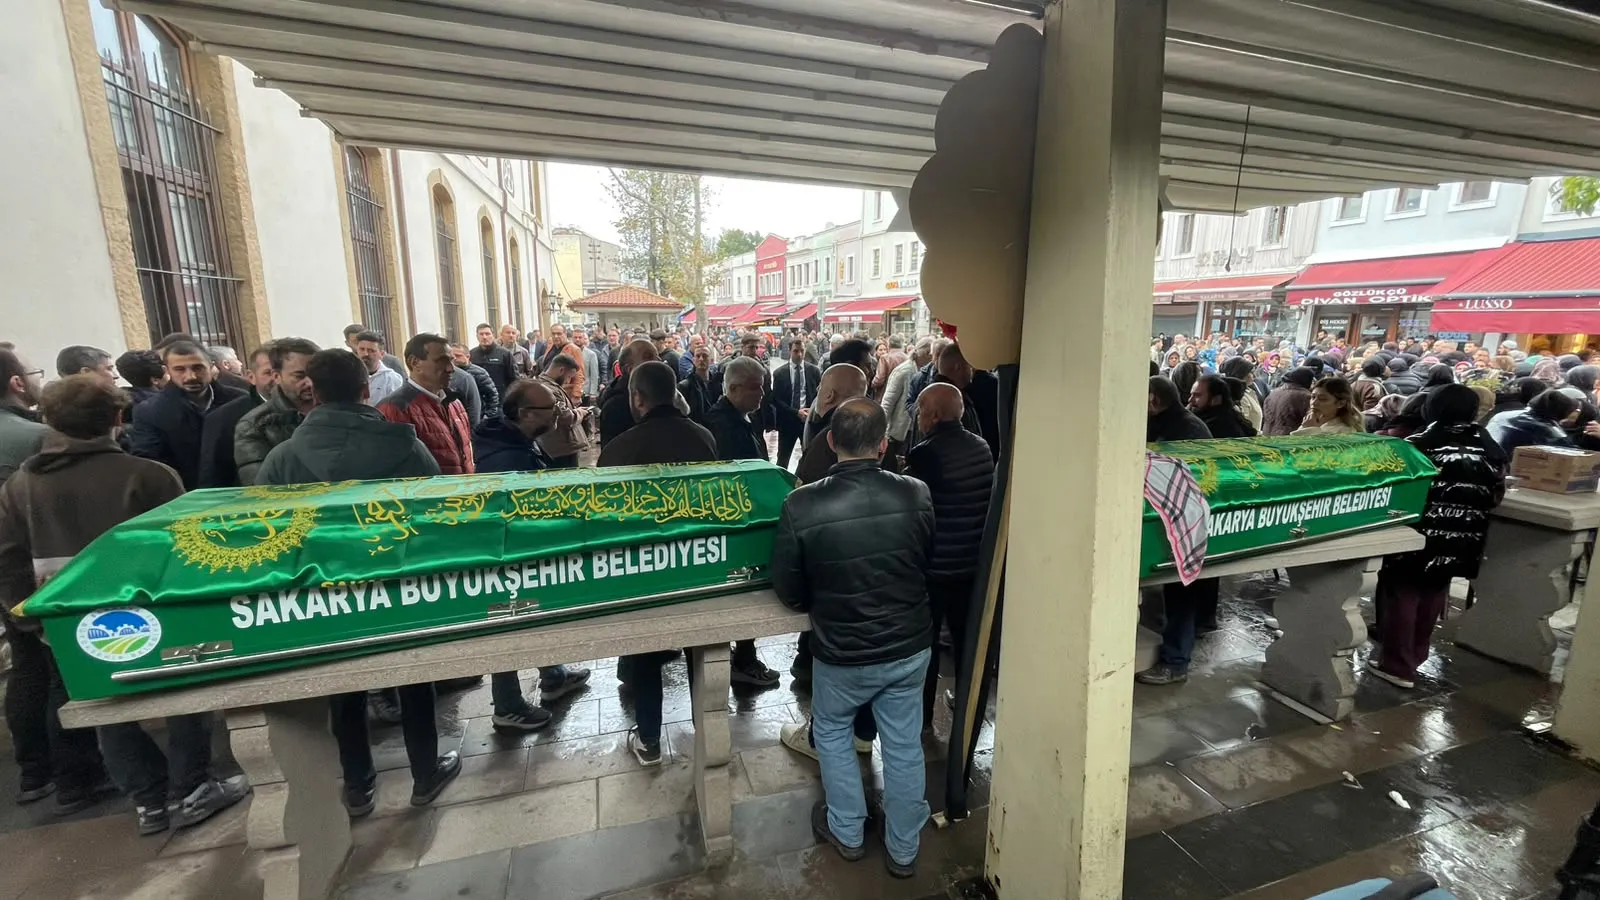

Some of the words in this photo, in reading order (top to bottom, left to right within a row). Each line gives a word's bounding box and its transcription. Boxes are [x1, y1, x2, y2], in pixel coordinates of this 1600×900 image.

[1464, 299, 1513, 309] LUSSO
[1207, 508, 1256, 537] AKARYA
[230, 580, 392, 629] SAKARYA
